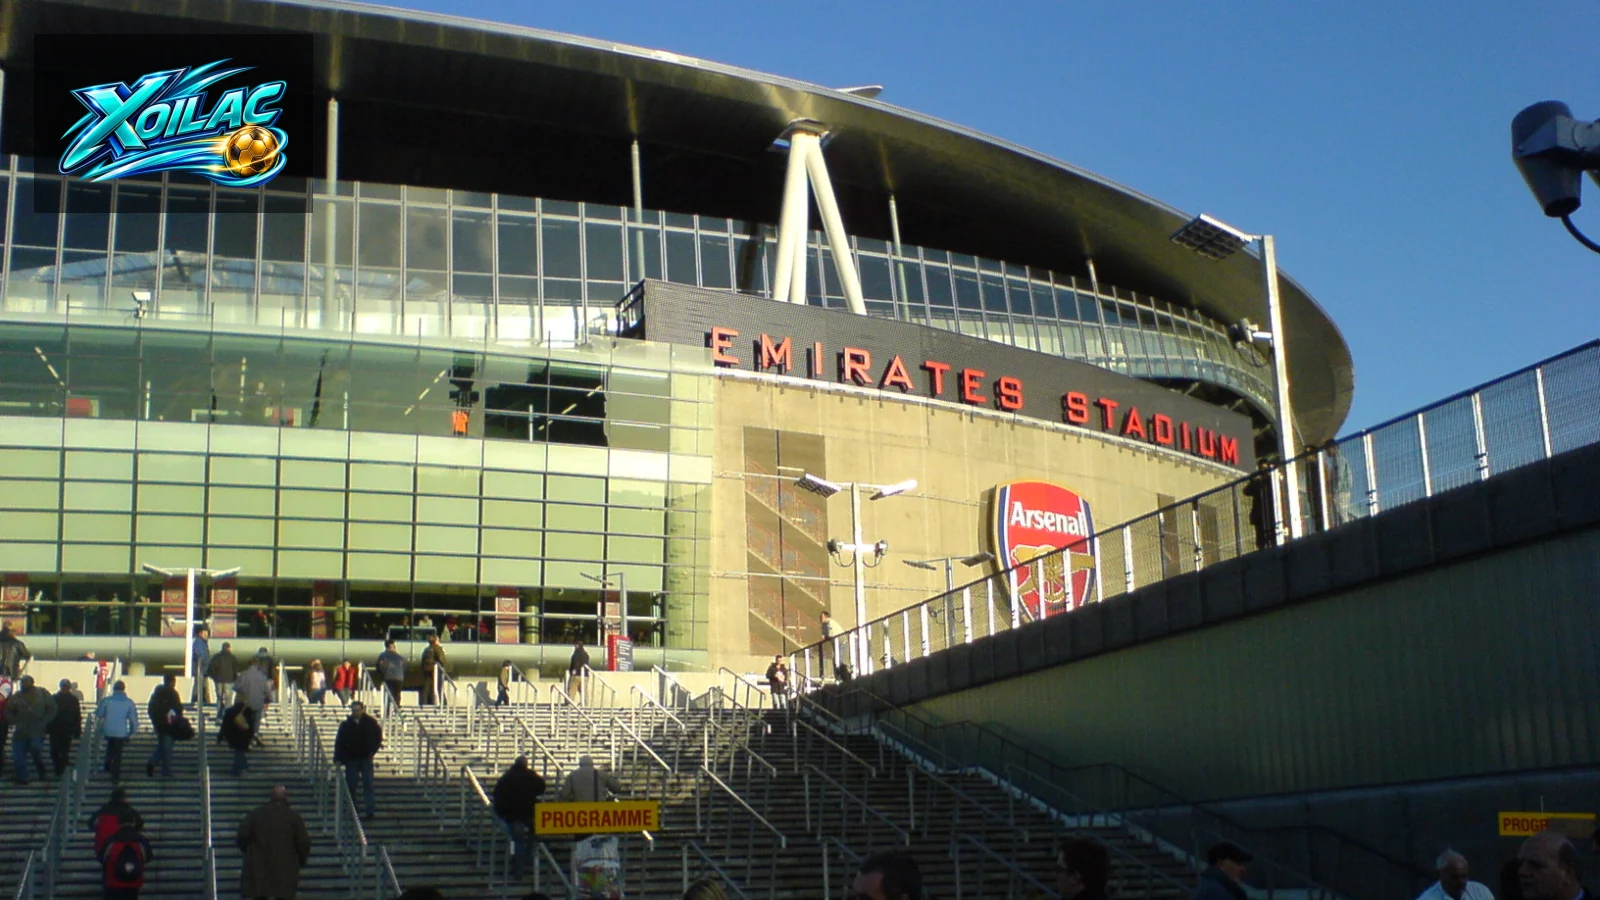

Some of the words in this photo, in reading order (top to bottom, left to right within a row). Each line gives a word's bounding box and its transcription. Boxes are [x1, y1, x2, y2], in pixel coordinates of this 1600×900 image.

[709, 325, 1024, 410] EMIRATES
[1064, 391, 1239, 465] STADIUM
[1010, 501, 1086, 537] Arsenal
[541, 809, 653, 828] PROGRAMME
[1502, 817, 1549, 832] PROGR
